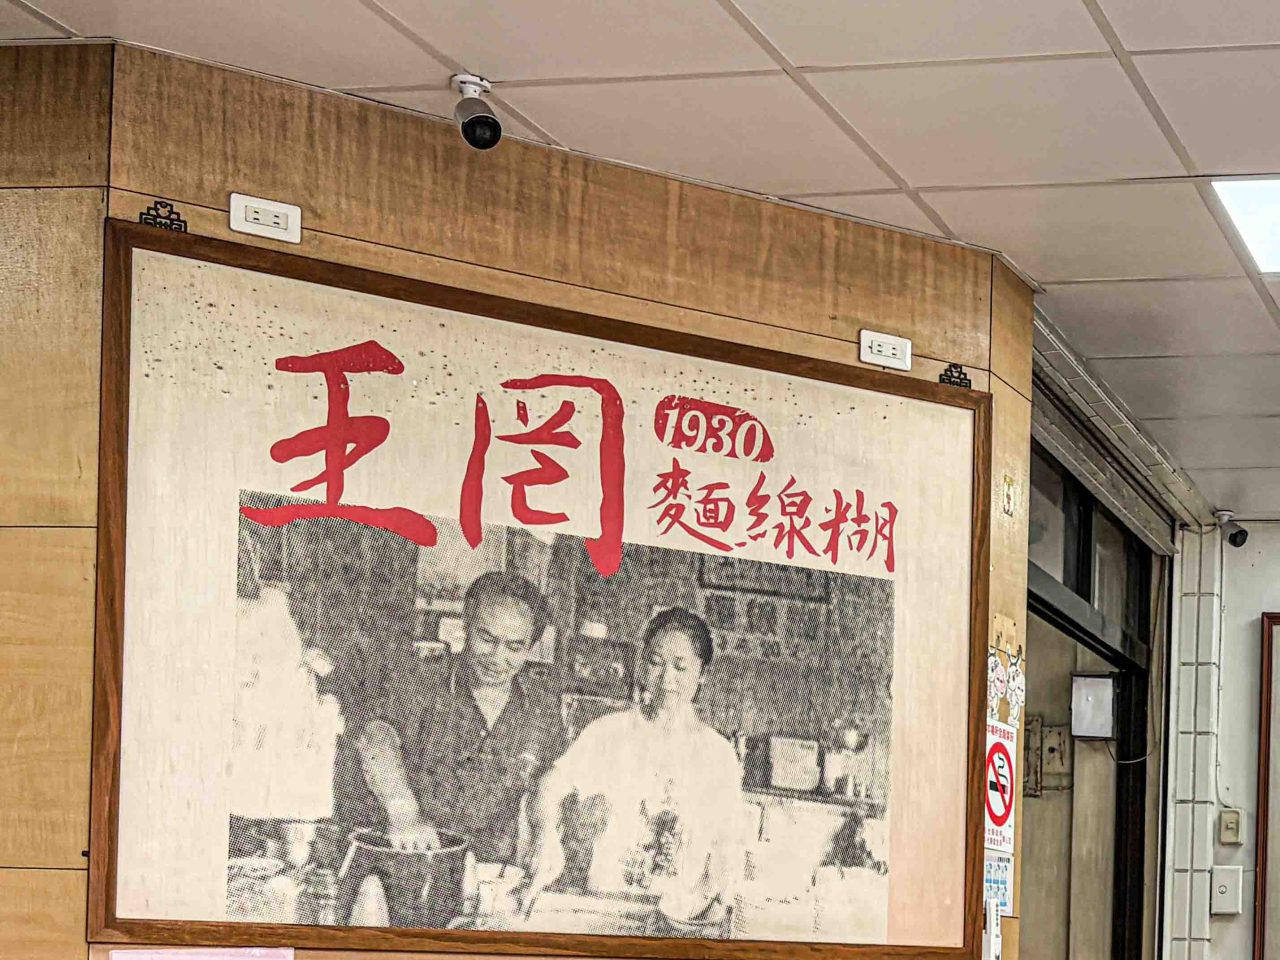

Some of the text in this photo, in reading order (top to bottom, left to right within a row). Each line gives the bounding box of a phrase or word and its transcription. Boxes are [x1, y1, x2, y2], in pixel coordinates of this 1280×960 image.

[663, 408, 764, 463] 1930
[648, 457, 898, 572] 麵線糊
